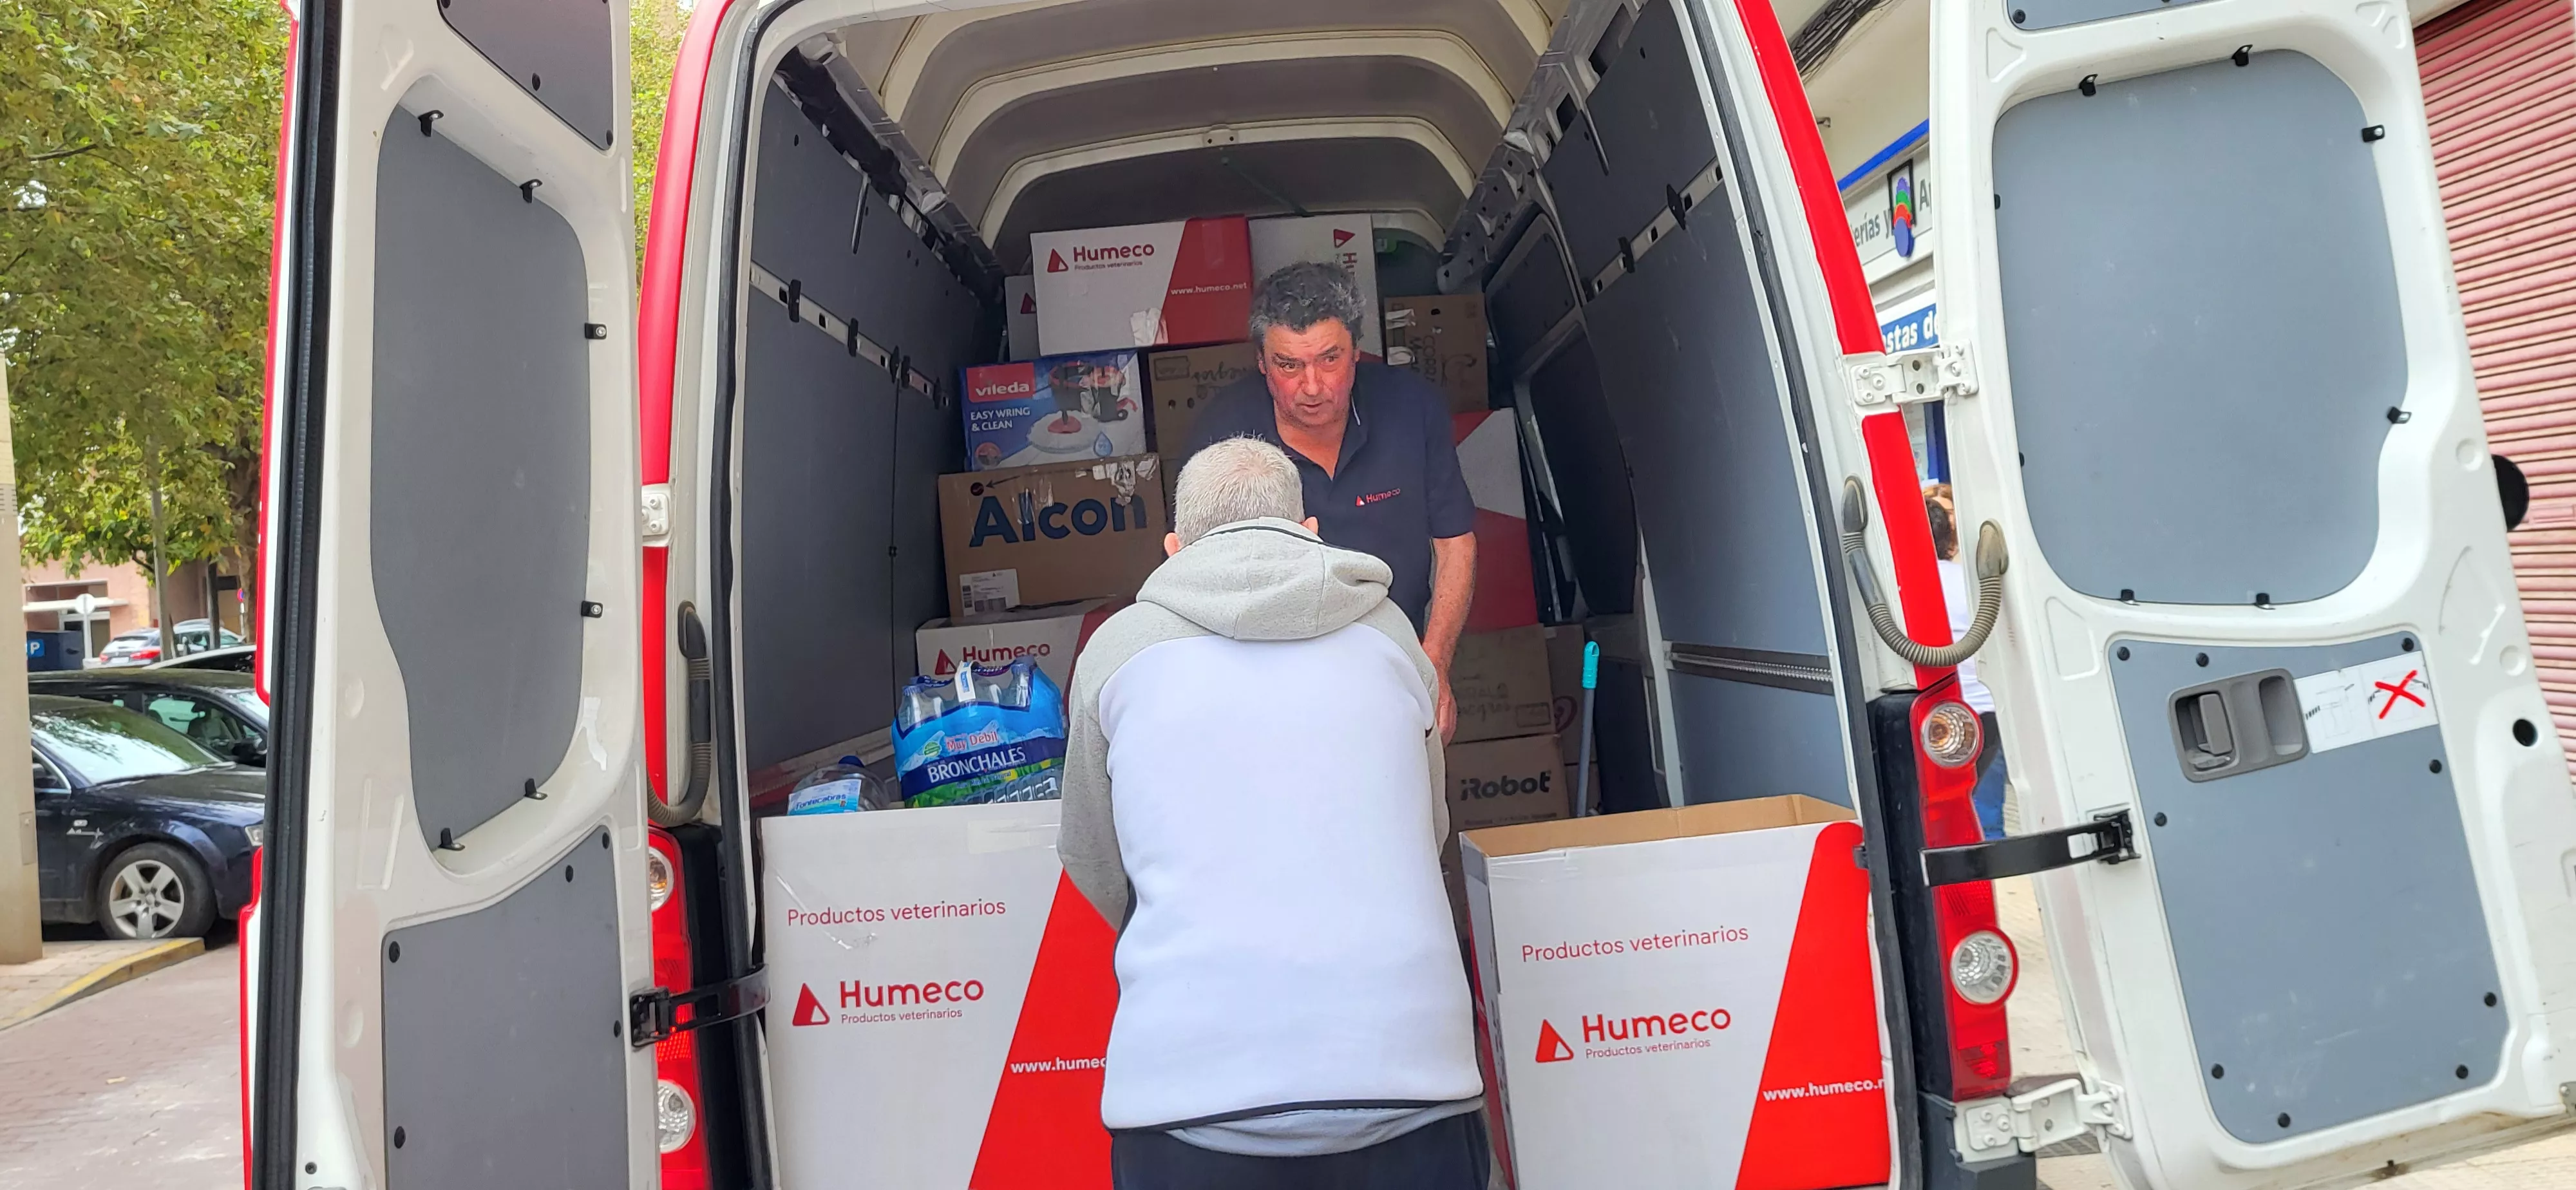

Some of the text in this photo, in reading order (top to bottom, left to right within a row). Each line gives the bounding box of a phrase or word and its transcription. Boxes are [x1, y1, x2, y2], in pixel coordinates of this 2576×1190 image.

[1851, 212, 1880, 247] erías
[1073, 244, 1155, 262] Humeco
[1171, 282, 1247, 295] www.humeco.net
[975, 382, 1030, 396] vileda
[971, 407, 1030, 420] EASY WRING
[971, 419, 1013, 431] & CLEAN
[1366, 488, 1401, 504] Humeco
[969, 492, 1147, 547] Alcon
[30, 642, 40, 655] P
[963, 643, 1050, 663] Humeco
[947, 740, 966, 751] Muy
[928, 747, 1026, 783] BRONCHALES
[1461, 770, 1551, 801] iRobot
[788, 898, 1006, 926] Productos veterinarios
[1522, 925, 1749, 963] Productos veterinarios
[840, 979, 984, 1008] Humeco
[841, 1008, 963, 1024] Productos veterinarios
[1582, 1008, 1731, 1043] Humeco
[1585, 1037, 1711, 1059] Productos veterinarios
